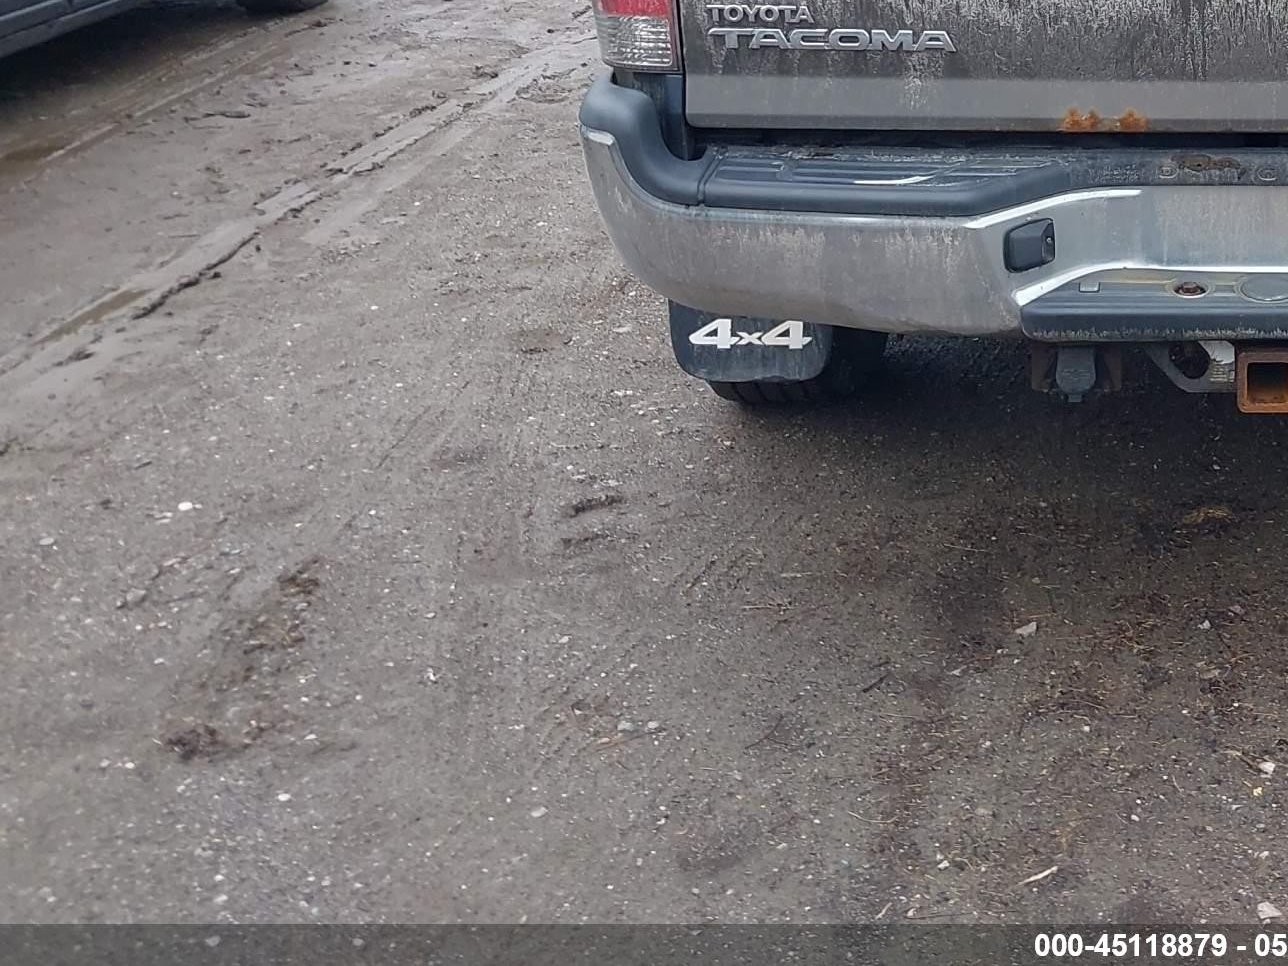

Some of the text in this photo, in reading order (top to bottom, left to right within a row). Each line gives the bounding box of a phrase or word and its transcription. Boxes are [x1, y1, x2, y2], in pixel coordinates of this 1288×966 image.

[706, 4, 814, 24] TOYOTA
[707, 27, 957, 52] TACOMA
[688, 318, 813, 350] 4x4
